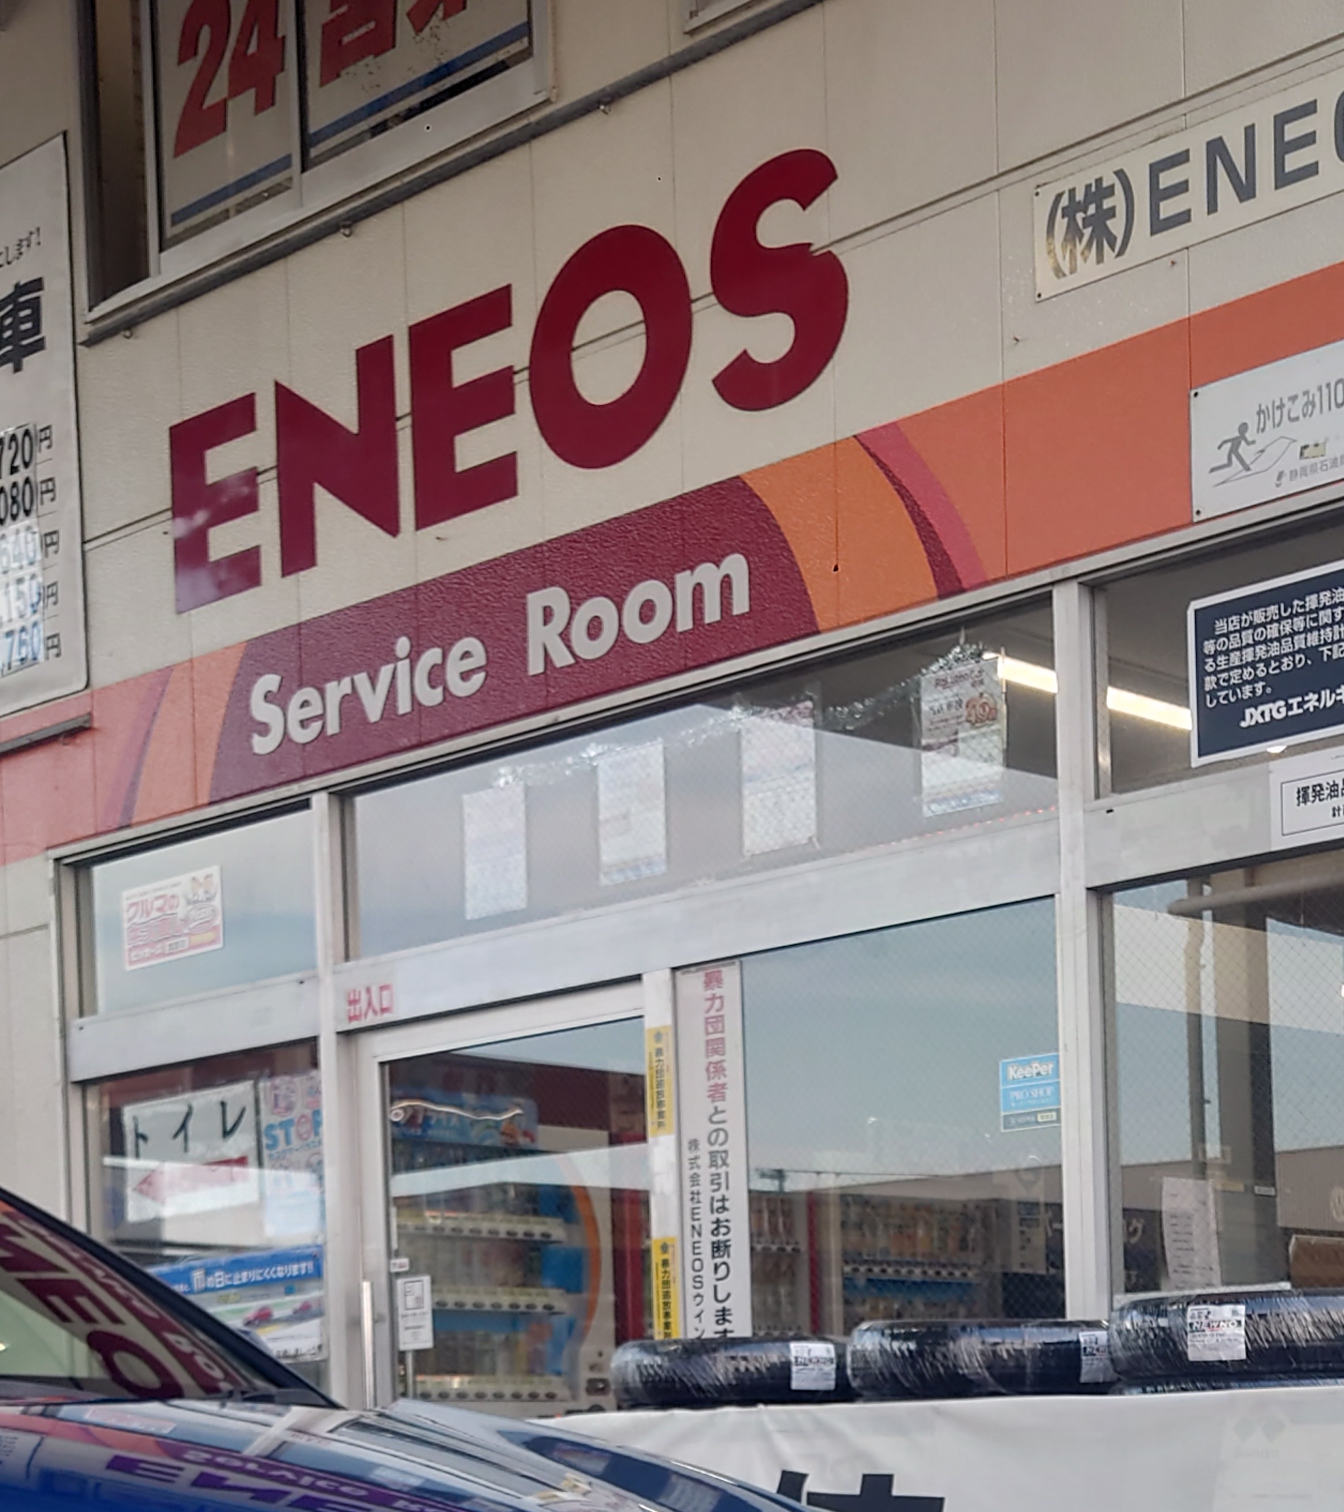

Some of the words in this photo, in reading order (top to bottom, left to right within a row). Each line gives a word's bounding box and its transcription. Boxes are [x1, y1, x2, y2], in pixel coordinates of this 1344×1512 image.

[169, 147, 850, 615] ENEOS
[250, 634, 487, 757] Service
[526, 551, 751, 676] Room
[1205, 681, 1273, 709] しています。
[347, 983, 395, 1022] 出入口
[1007, 1061, 1055, 1081] KeePer
[133, 1099, 247, 1160] トイレ
